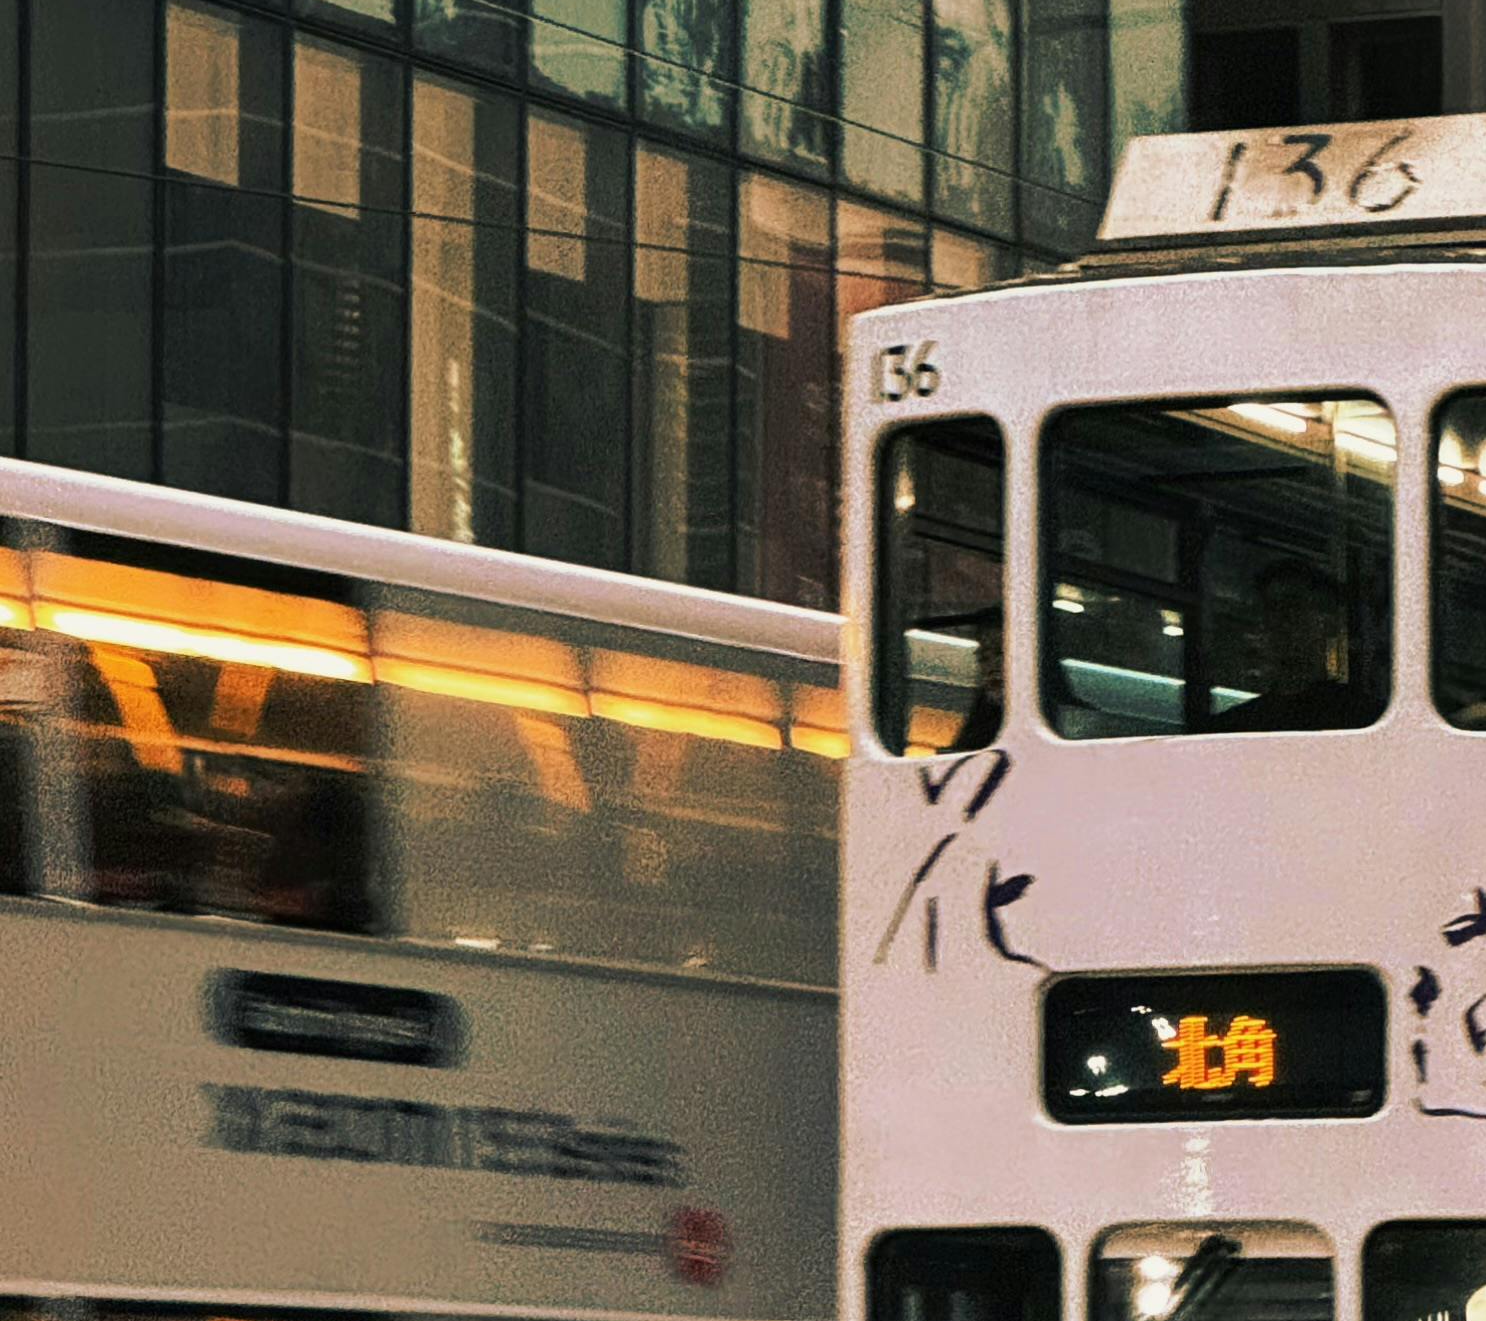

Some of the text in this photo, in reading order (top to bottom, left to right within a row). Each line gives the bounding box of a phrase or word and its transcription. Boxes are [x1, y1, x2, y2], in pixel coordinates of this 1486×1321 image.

[1207, 131, 1420, 222] 136
[871, 340, 941, 402] 136
[1162, 1015, 1277, 1091] 北角
